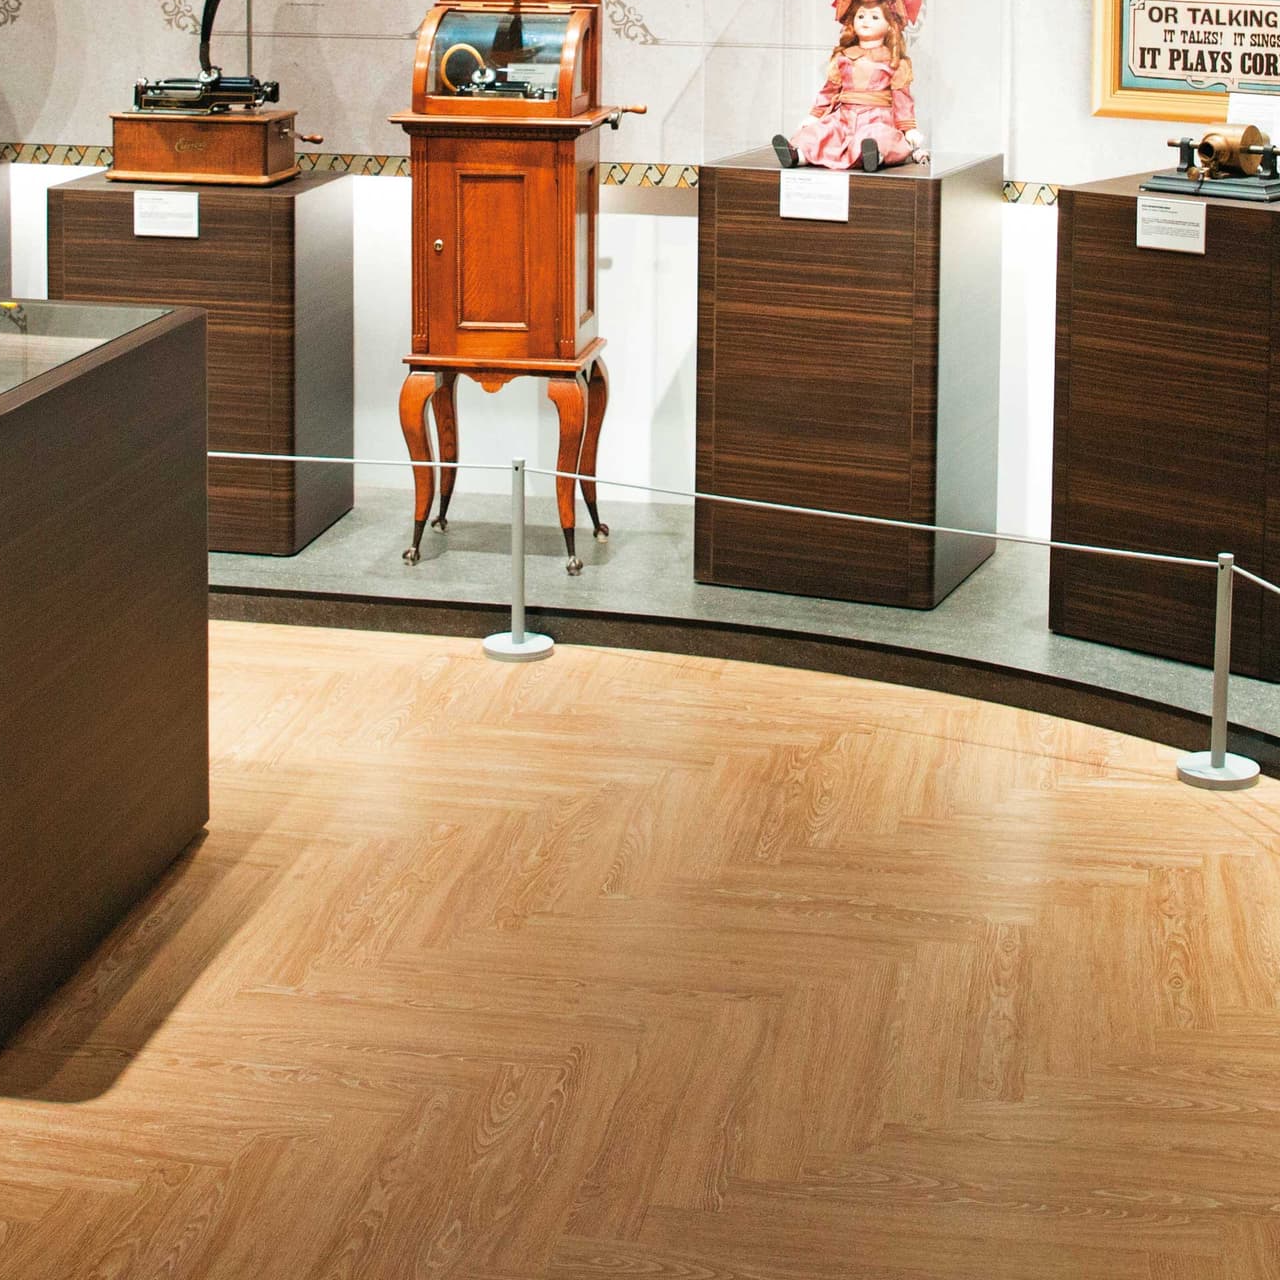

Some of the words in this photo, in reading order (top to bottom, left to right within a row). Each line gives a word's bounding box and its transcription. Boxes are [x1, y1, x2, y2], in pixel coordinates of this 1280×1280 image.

[1148, 6, 1178, 24] OR
[1187, 7, 1278, 28] TALKING
[1163, 29, 1177, 43] IT
[1180, 30, 1223, 45] TALKS!
[1233, 32, 1245, 46] IT
[1139, 47, 1160, 69] IT
[1169, 48, 1232, 73] PLAYS
